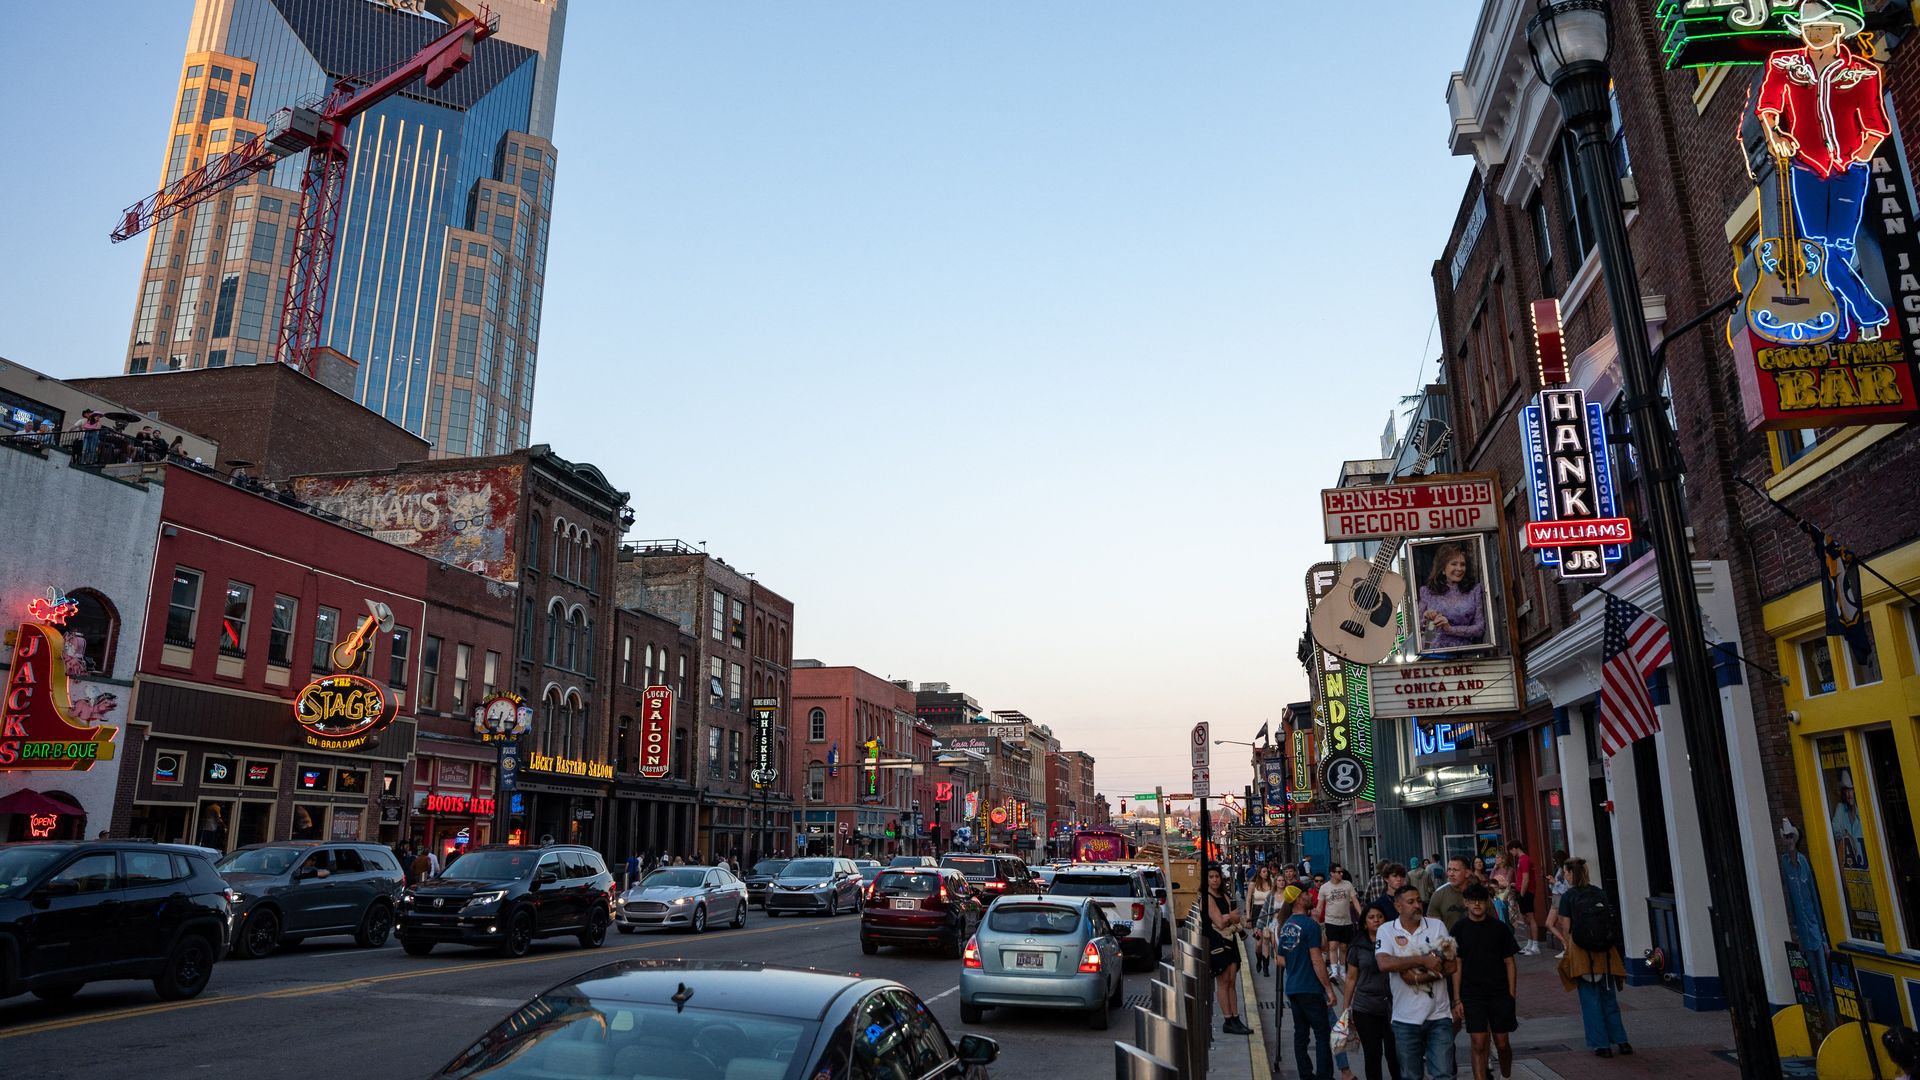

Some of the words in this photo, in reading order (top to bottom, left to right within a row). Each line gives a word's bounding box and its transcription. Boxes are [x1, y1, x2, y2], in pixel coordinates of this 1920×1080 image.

[1872, 156, 1906, 235] ALAN
[1757, 344, 1829, 370] GOOD
[1833, 340, 1904, 365] TIME
[1776, 364, 1903, 411] BAR
[1529, 418, 1543, 463] DRINK
[1589, 418, 1601, 447] BAR
[1547, 393, 1591, 517] HANK
[1594, 450, 1609, 505] BOOGIE
[1327, 486, 1417, 513] ERNEST
[1429, 482, 1489, 505] TUBB
[1537, 482, 1549, 508] EAT
[1340, 511, 1420, 535] RECORD
[1429, 507, 1481, 530] SHOP
[1534, 523, 1627, 541] WILLIAMS
[1566, 550, 1600, 570] JR
[334, 678, 350, 686] THE
[1400, 664, 1475, 679] WELCOME
[0, 635, 42, 764] JACKS
[646, 691, 670, 699] LUCKY
[1394, 681, 1447, 695] CONICA
[1456, 679, 1484, 690] AND
[299, 685, 380, 724] STAGE
[1407, 694, 1472, 709] SERAFIN
[647, 699, 663, 765] SALOON
[1354, 684, 1367, 753] PLACES
[22, 743, 97, 758] BAR-B-QUE
[307, 736, 317, 746] ON
[321, 736, 366, 748] BROADWAY
[759, 711, 769, 769] WHISKEY
[530, 752, 554, 771] LUCKY
[556, 755, 587, 776] BASTARD
[588, 760, 614, 779] SALOON
[642, 765, 669, 773] BASTARD
[1295, 732, 1304, 788] MERCHANTS
[427, 795, 465, 813] BOOTS
[469, 798, 495, 814] HATS
[33, 818, 53, 827] OPEN
[1835, 995, 1862, 1020] BAR
